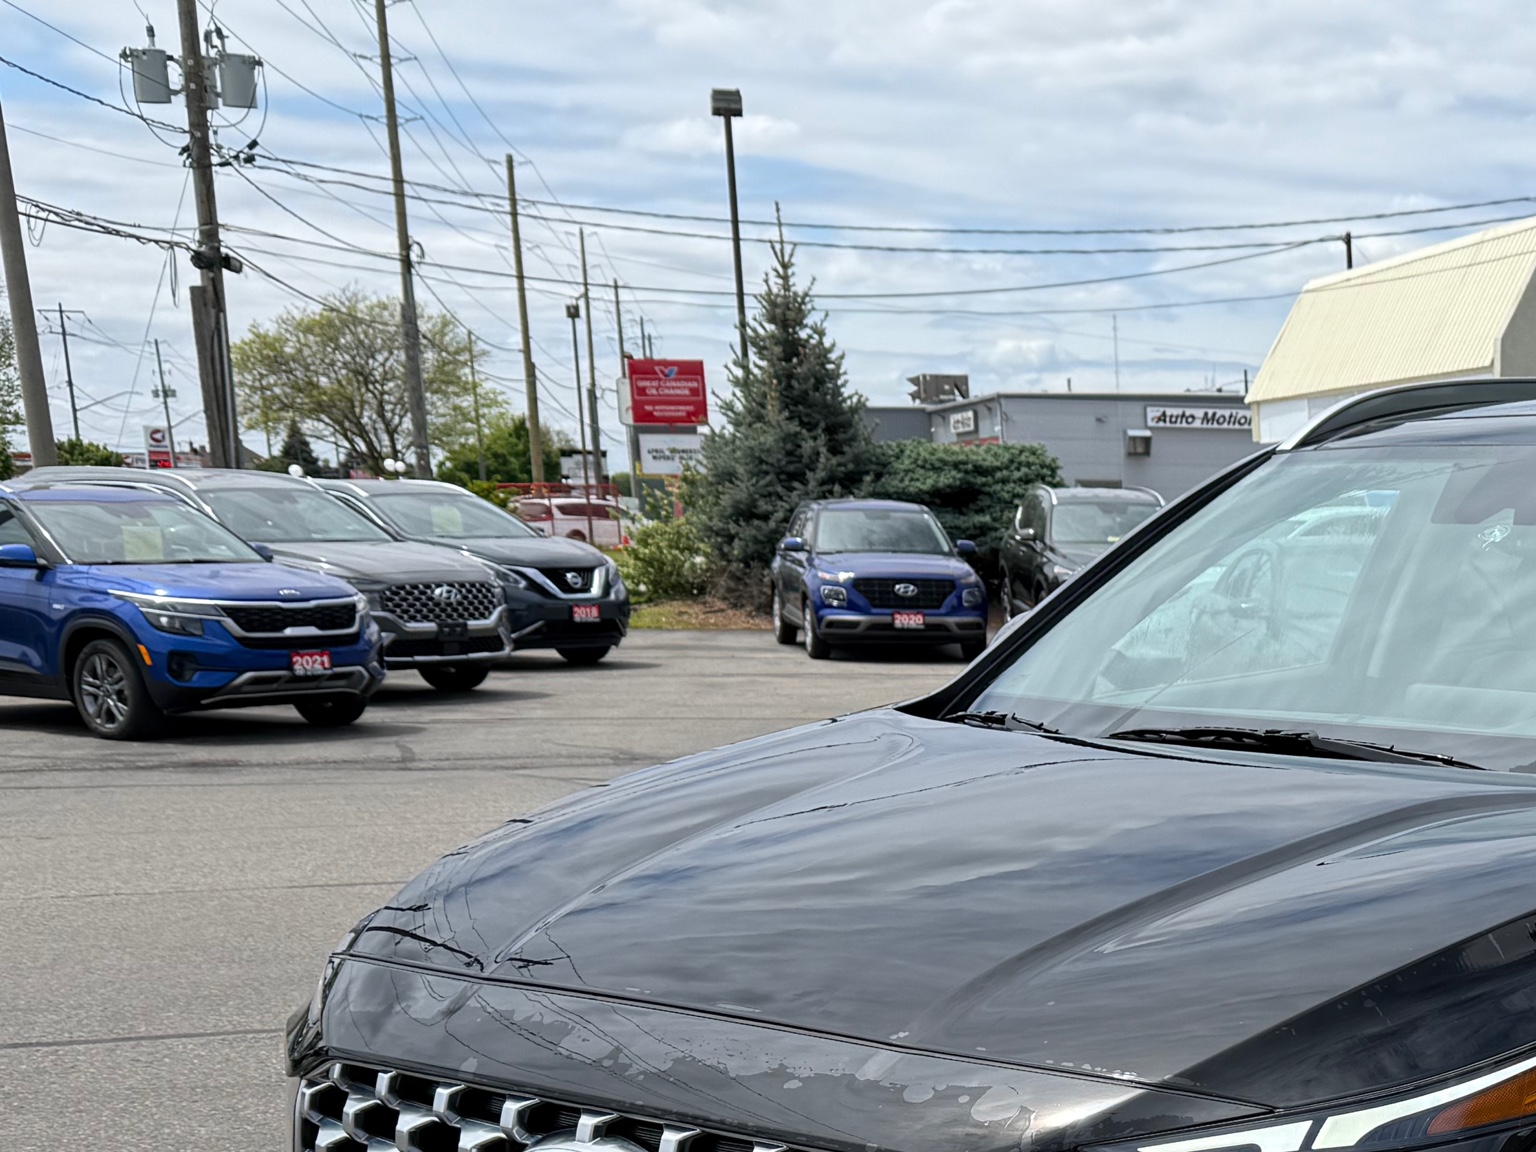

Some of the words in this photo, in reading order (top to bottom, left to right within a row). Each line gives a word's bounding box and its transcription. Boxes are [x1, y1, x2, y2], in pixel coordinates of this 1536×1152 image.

[660, 380, 698, 388] CANADIAN
[658, 388, 690, 396] CHANGE
[1155, 410, 1195, 425] Auto
[893, 613, 924, 625] 2020
[292, 655, 330, 670] 2021
